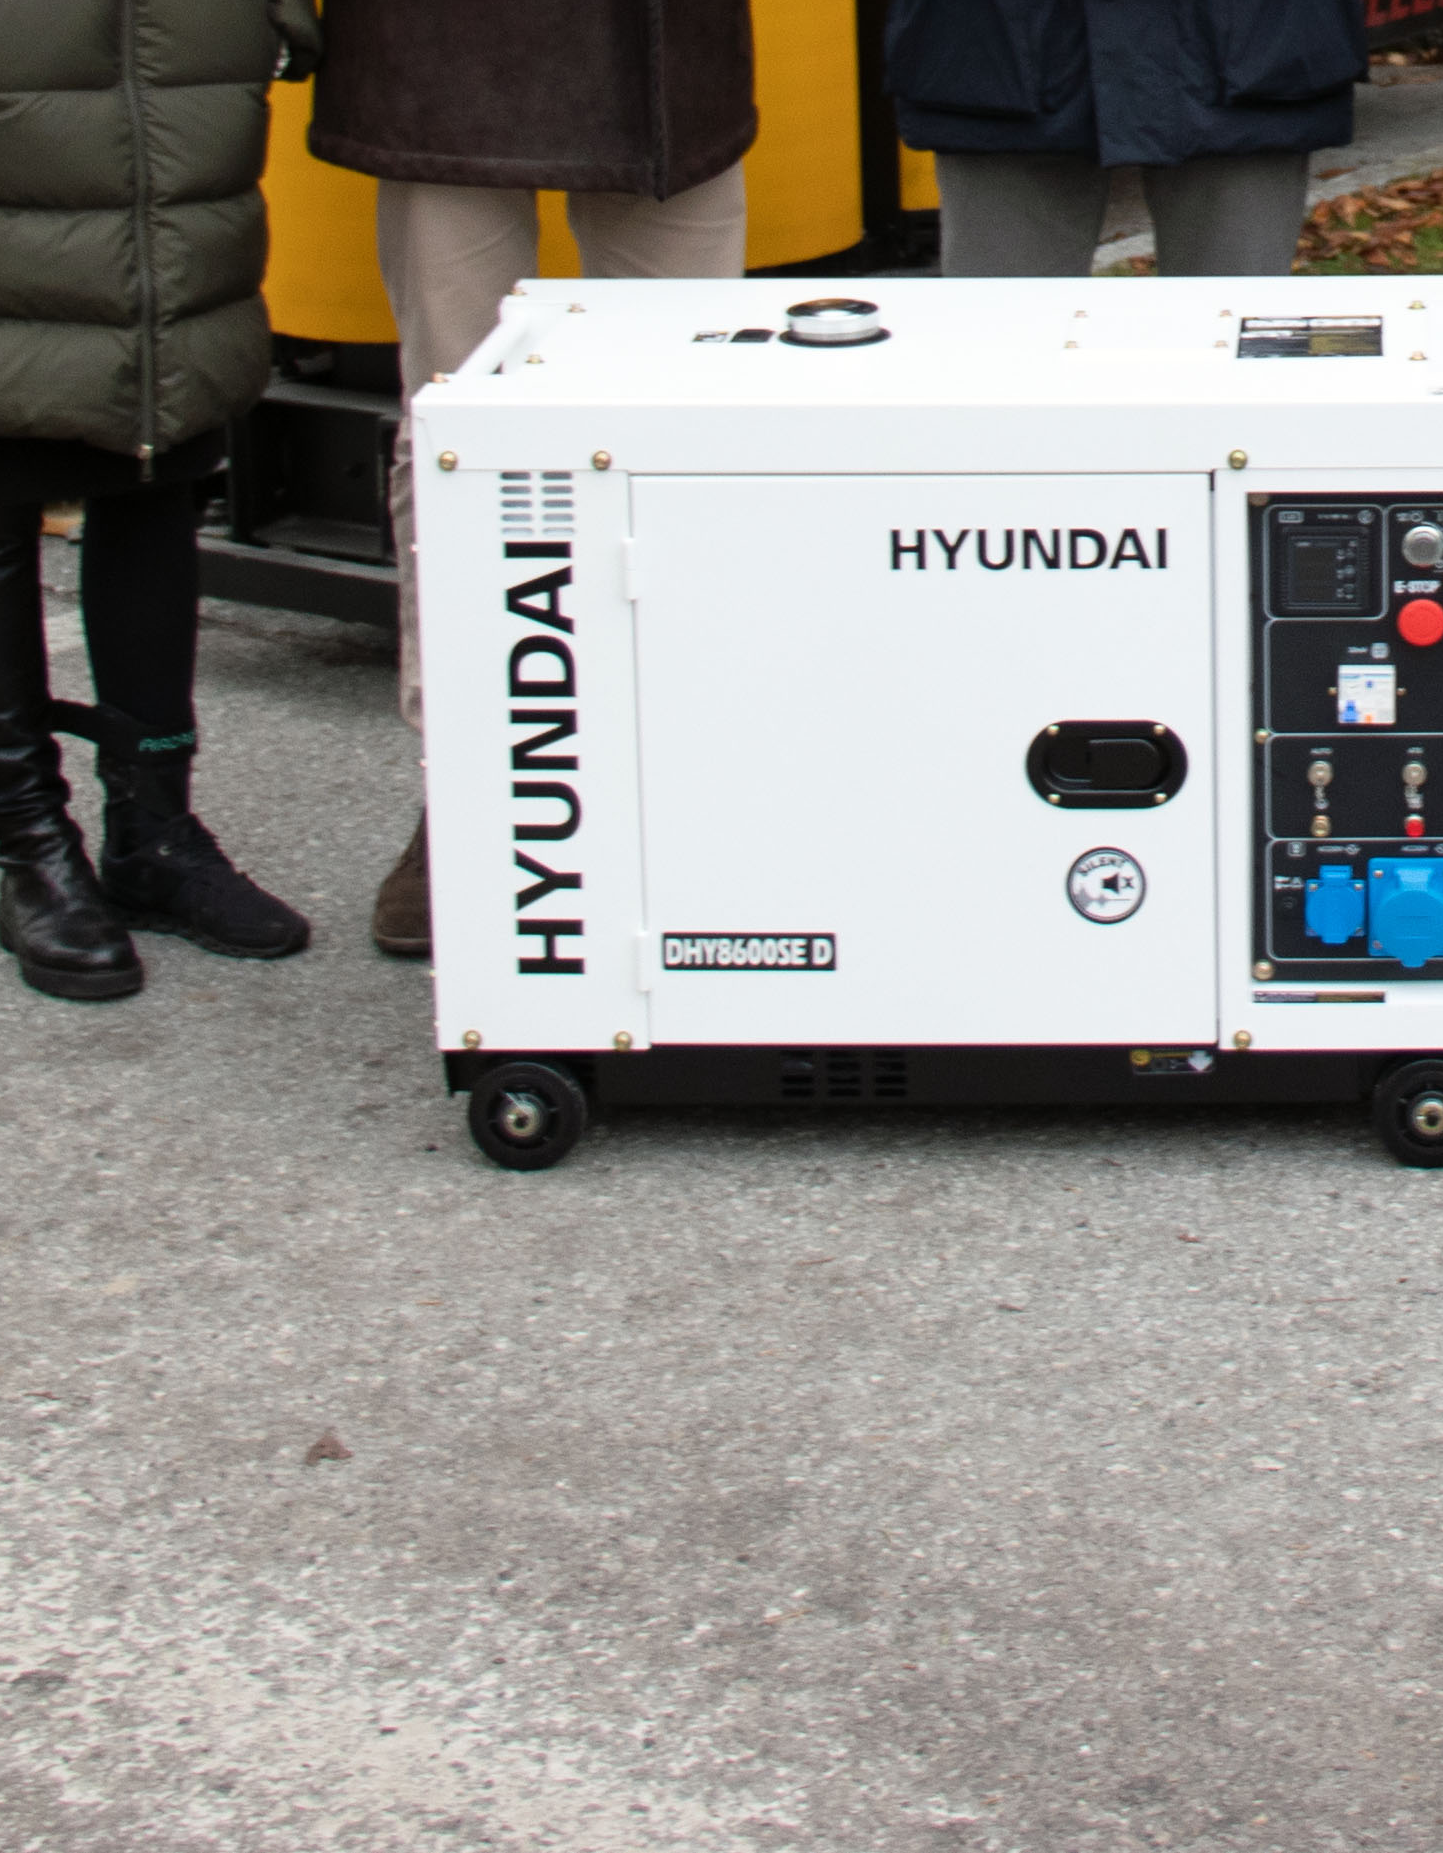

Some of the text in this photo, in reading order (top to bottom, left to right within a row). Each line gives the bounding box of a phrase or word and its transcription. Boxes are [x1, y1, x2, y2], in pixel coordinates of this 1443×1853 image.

[890, 527, 1170, 572] HYUNDAI
[503, 538, 587, 977] HYUNDAI
[1076, 855, 1130, 877] SILENT
[664, 938, 834, 966] DHY8600SE D
